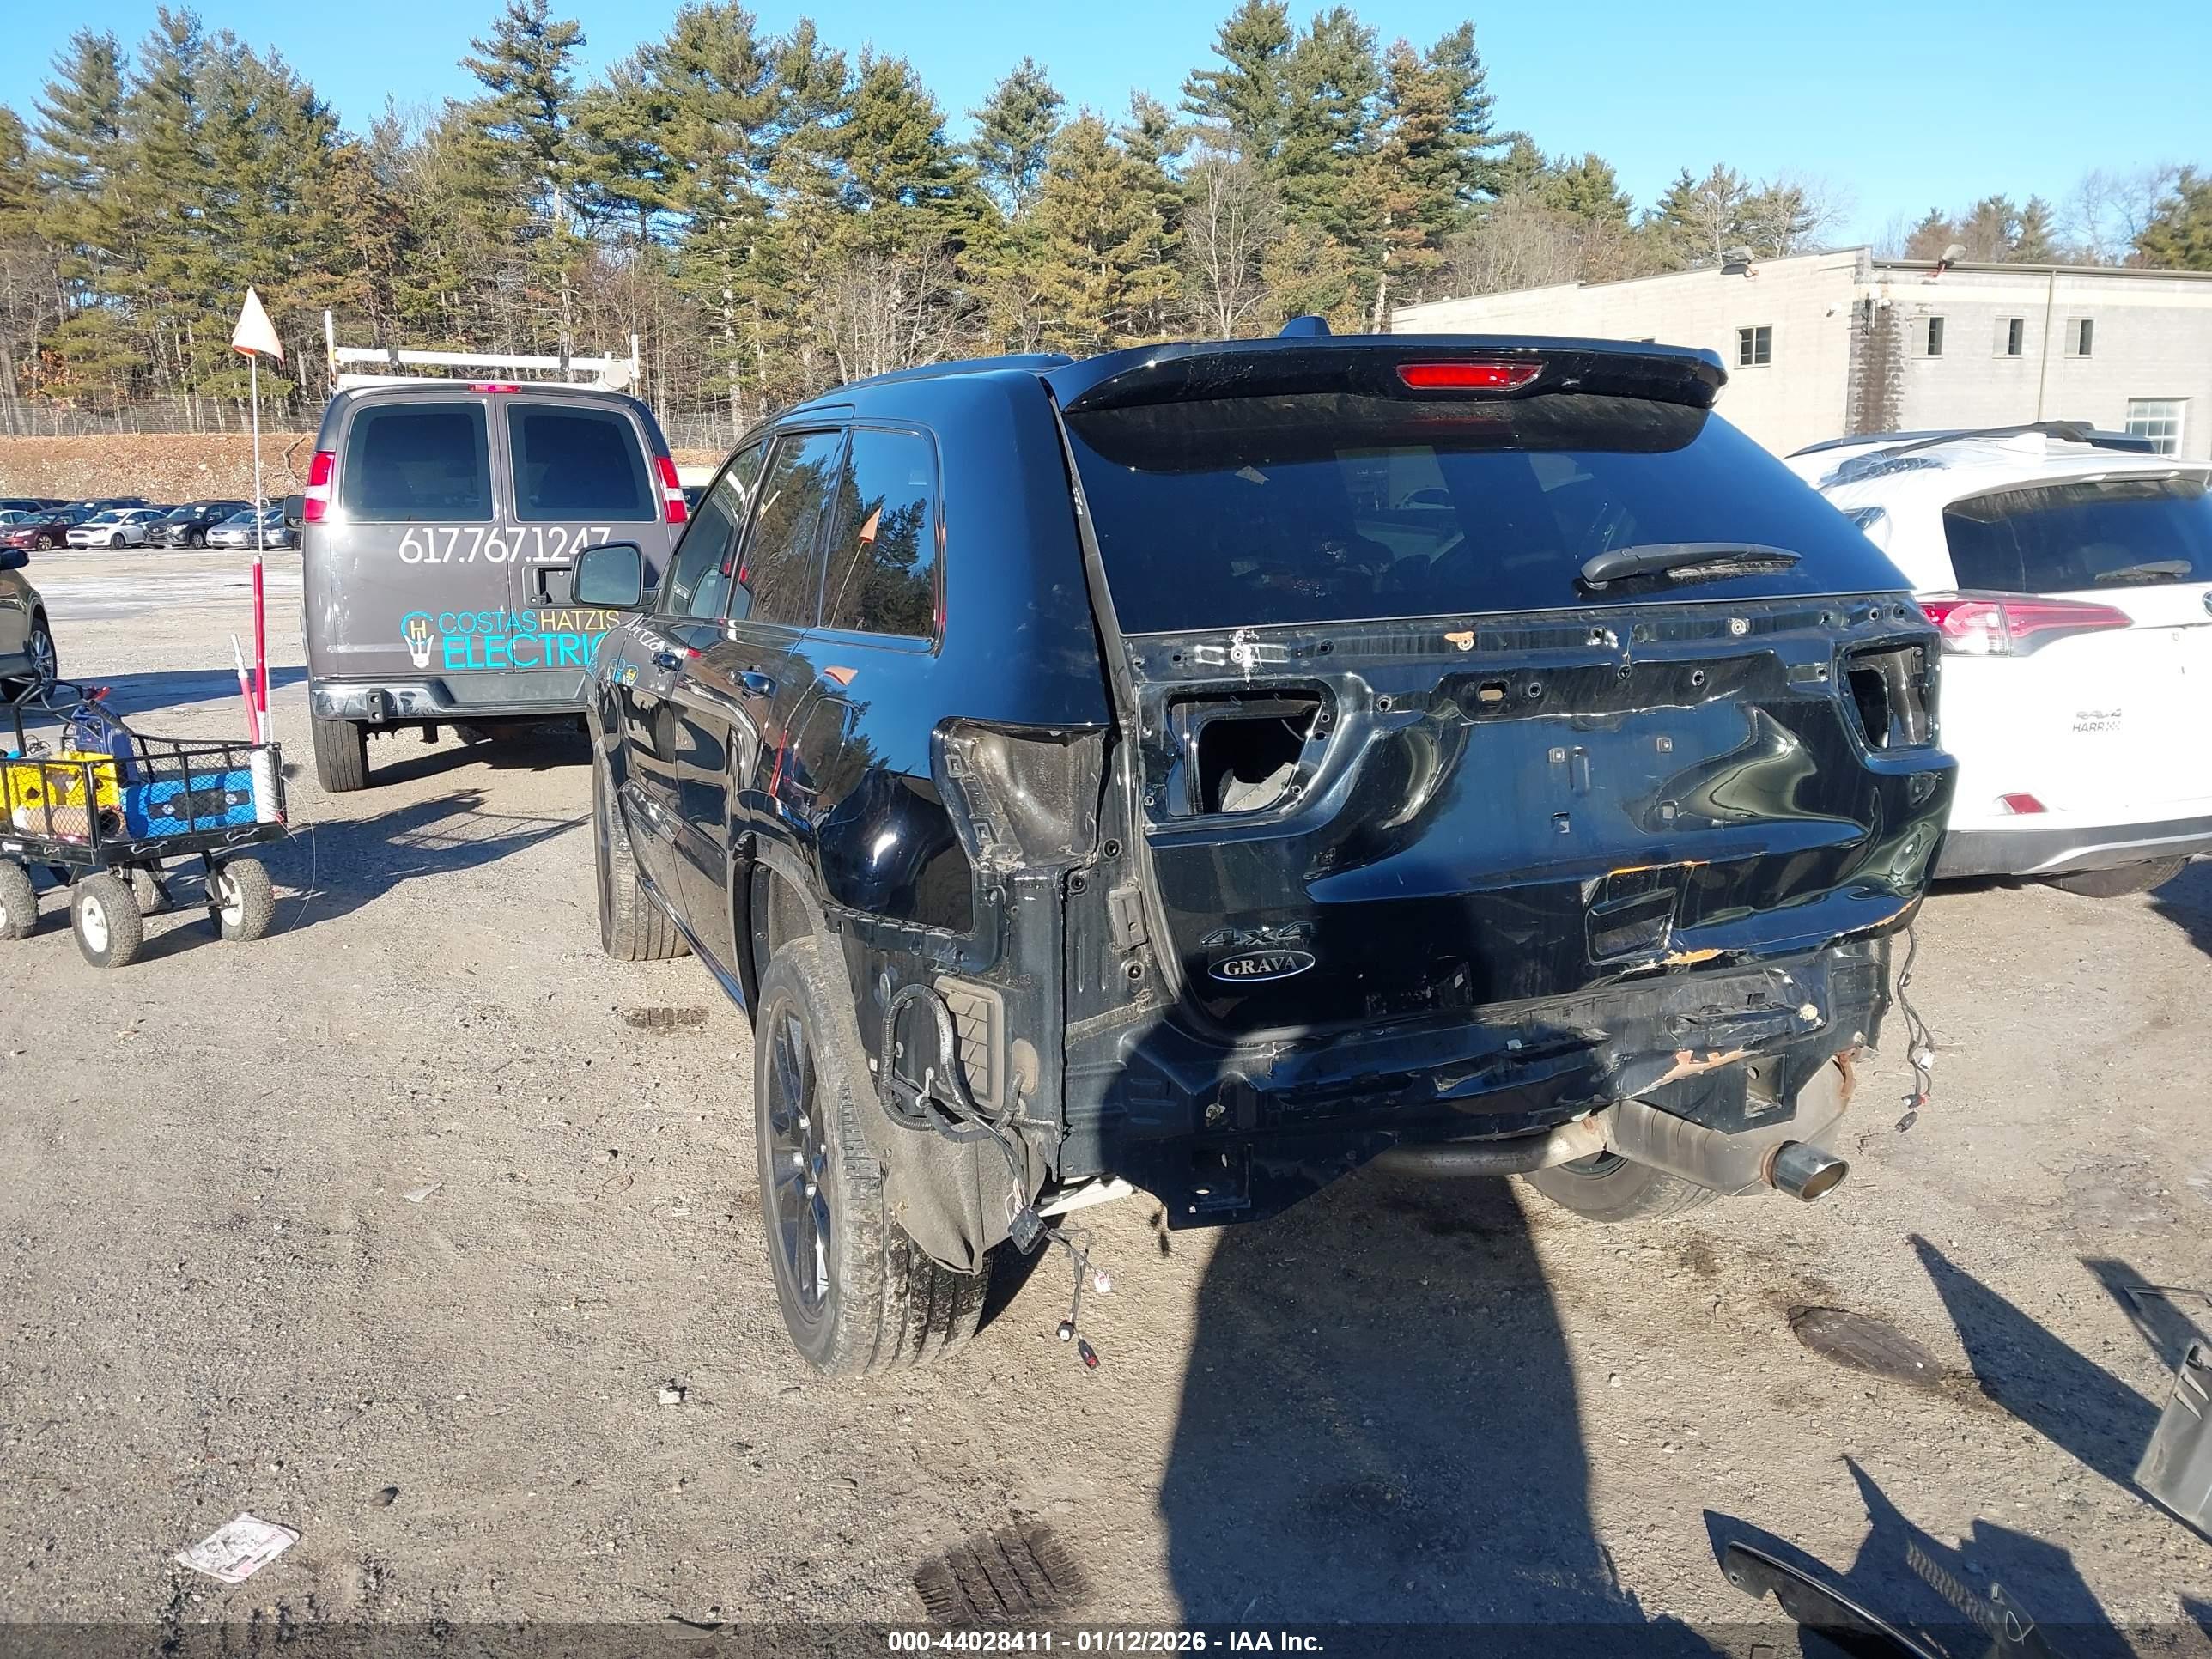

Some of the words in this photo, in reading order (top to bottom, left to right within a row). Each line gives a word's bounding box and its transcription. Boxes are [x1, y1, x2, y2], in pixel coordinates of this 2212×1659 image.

[439, 611, 537, 634] COSTAS
[540, 609, 621, 631] HATZIS
[1223, 955, 1299, 976] GRAVA
